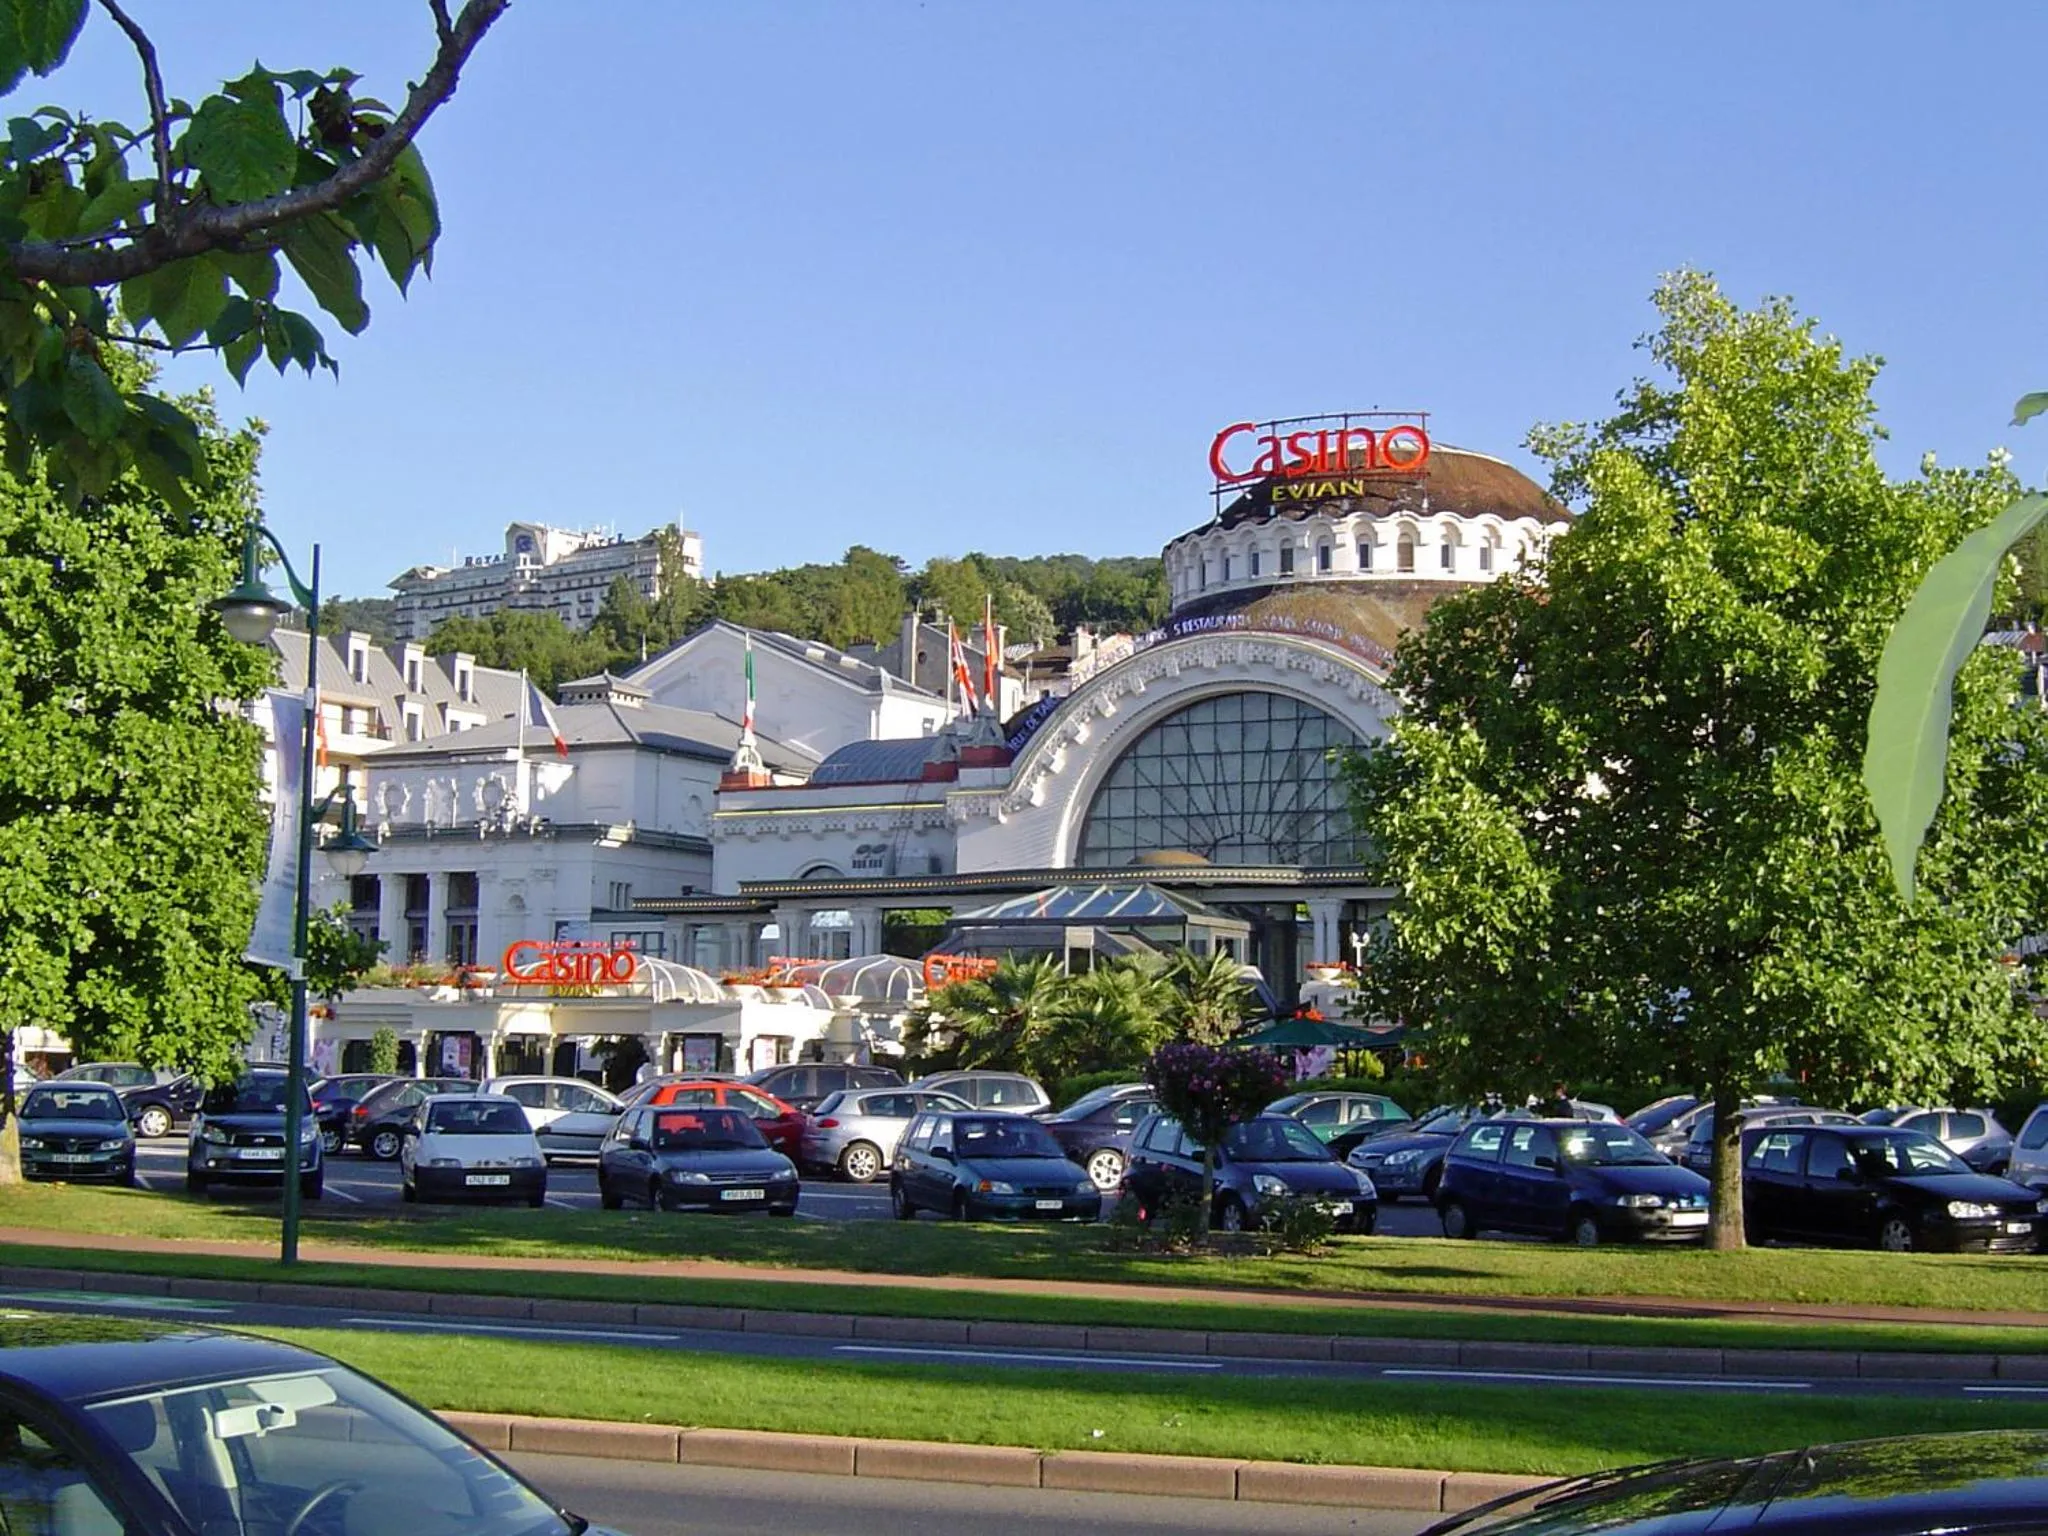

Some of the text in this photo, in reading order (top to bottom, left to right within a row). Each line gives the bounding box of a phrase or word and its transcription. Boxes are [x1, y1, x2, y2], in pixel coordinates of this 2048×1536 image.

[1209, 422, 1430, 484] Casino
[1272, 479, 1364, 502] EVIAN
[503, 940, 637, 984] Casino
